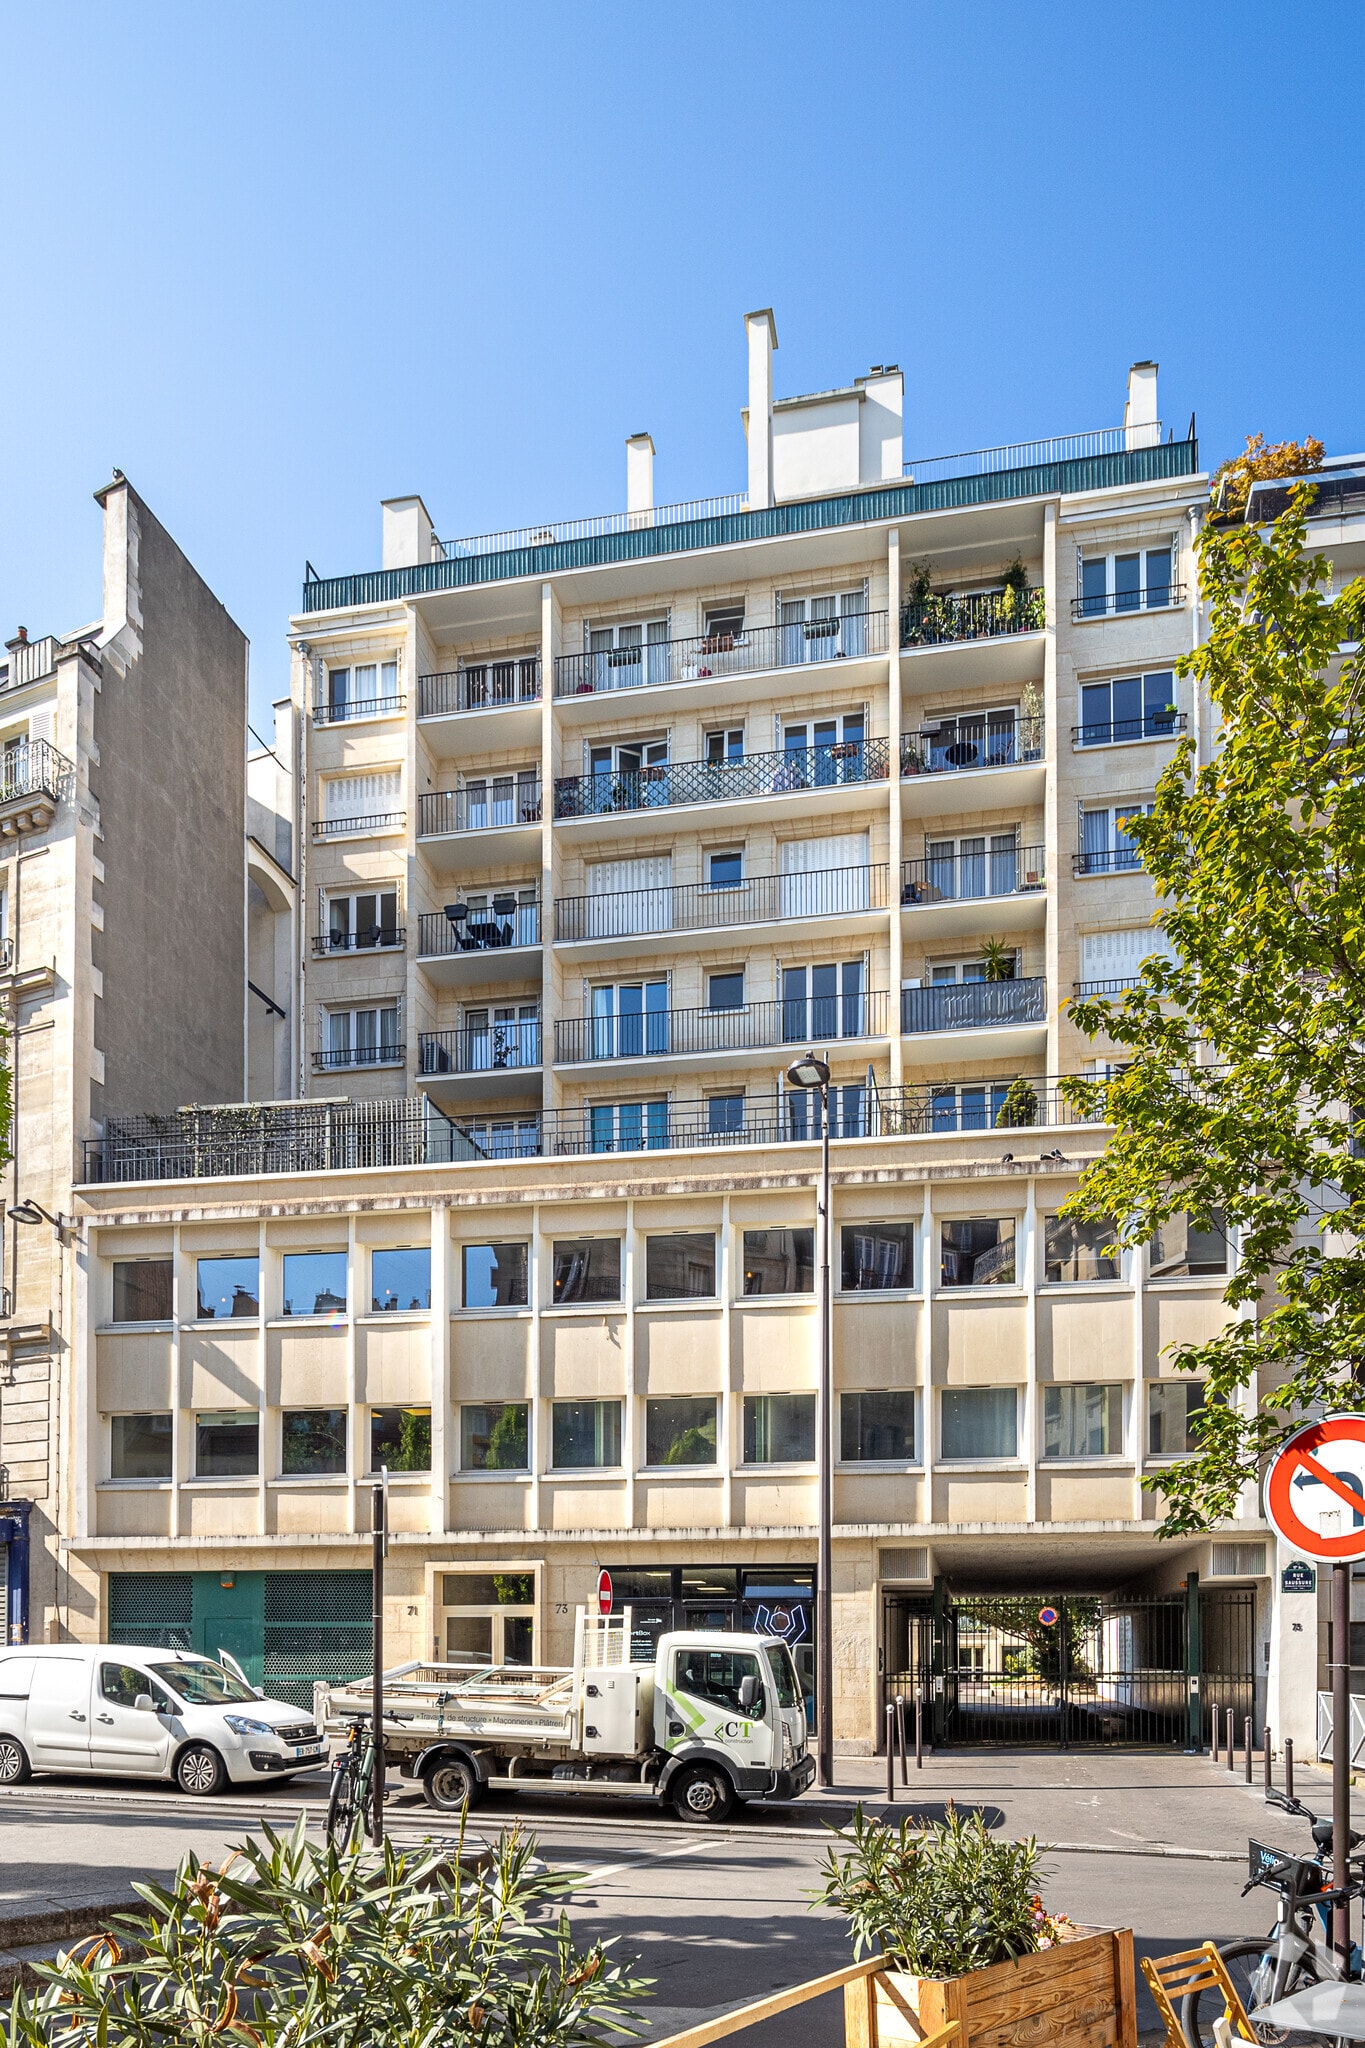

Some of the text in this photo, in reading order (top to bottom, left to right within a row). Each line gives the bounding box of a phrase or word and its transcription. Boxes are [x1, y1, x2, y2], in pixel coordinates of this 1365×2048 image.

[407, 1606, 417, 1616] 71
[555, 1603, 568, 1614] 73
[457, 1715, 487, 1723] structure
[493, 1716, 533, 1726] Maçonnerie
[725, 1721, 753, 1738] CT
